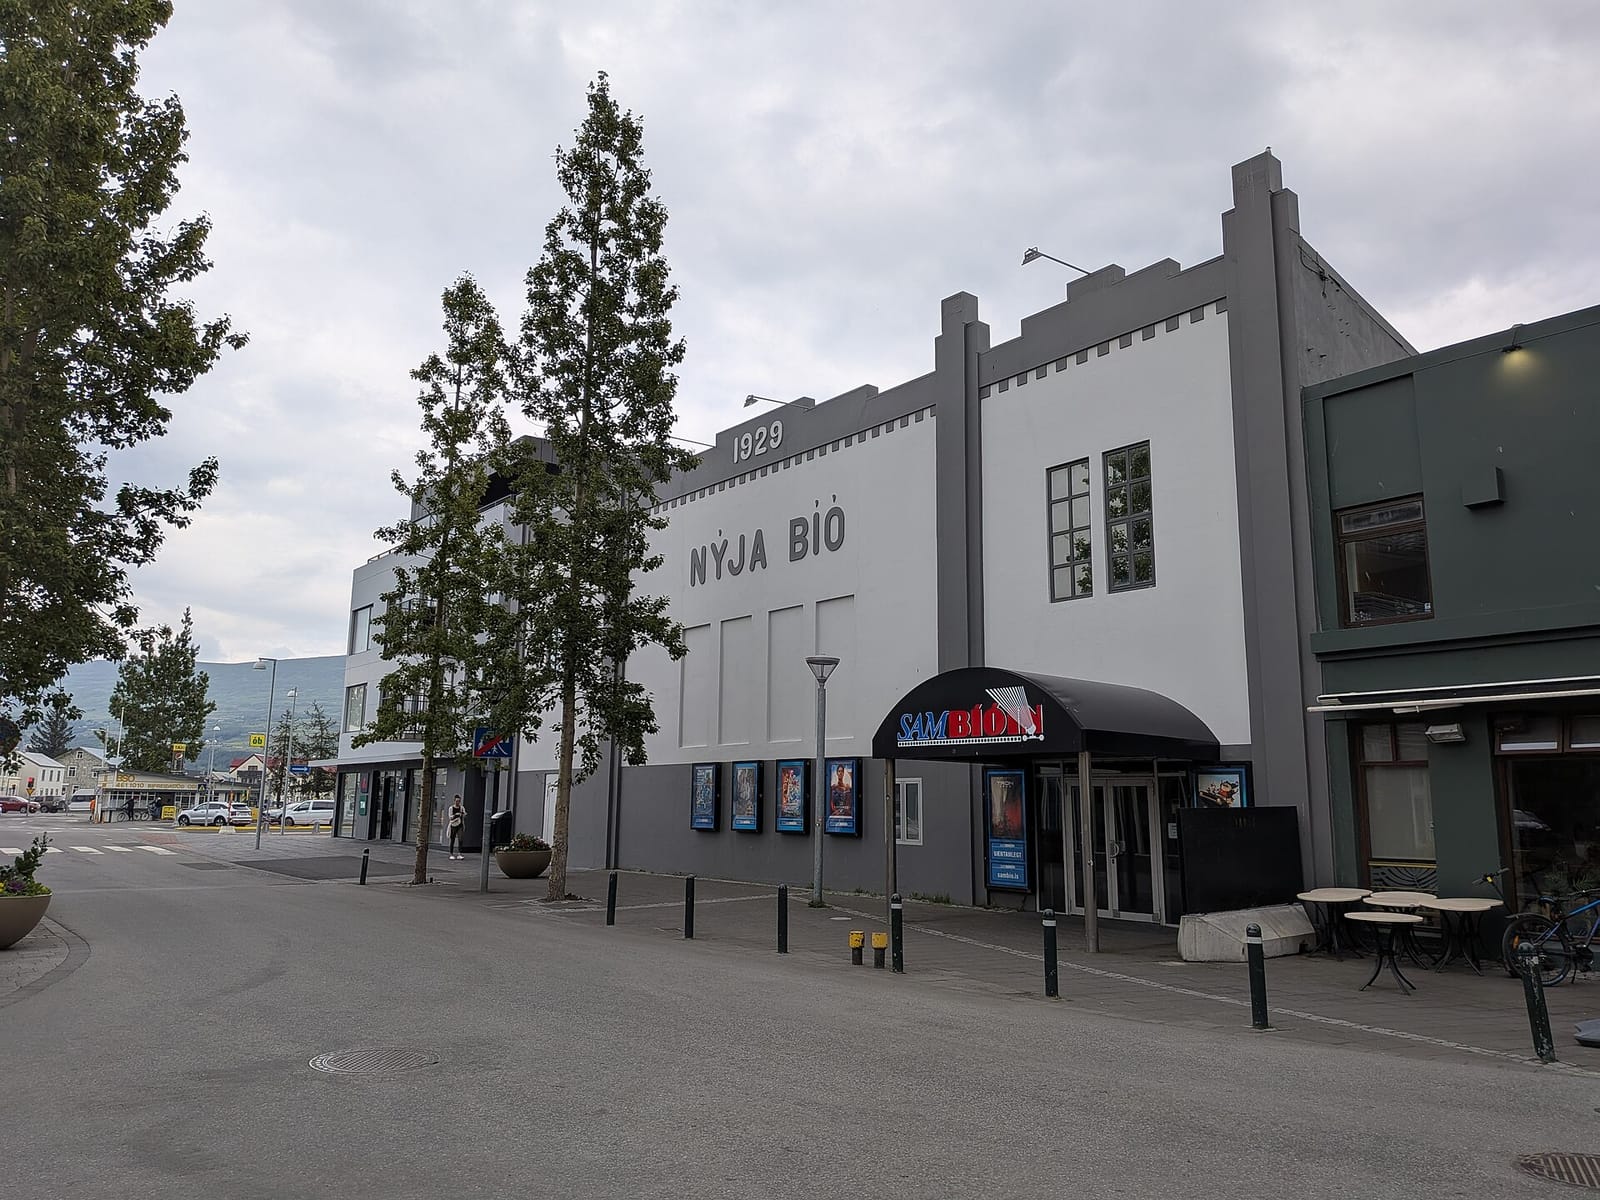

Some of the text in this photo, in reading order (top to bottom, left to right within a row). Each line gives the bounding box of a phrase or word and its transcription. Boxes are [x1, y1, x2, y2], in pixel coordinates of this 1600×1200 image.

[733, 420, 784, 464] 1929
[690, 494, 846, 588] NÝJA BÍÓ
